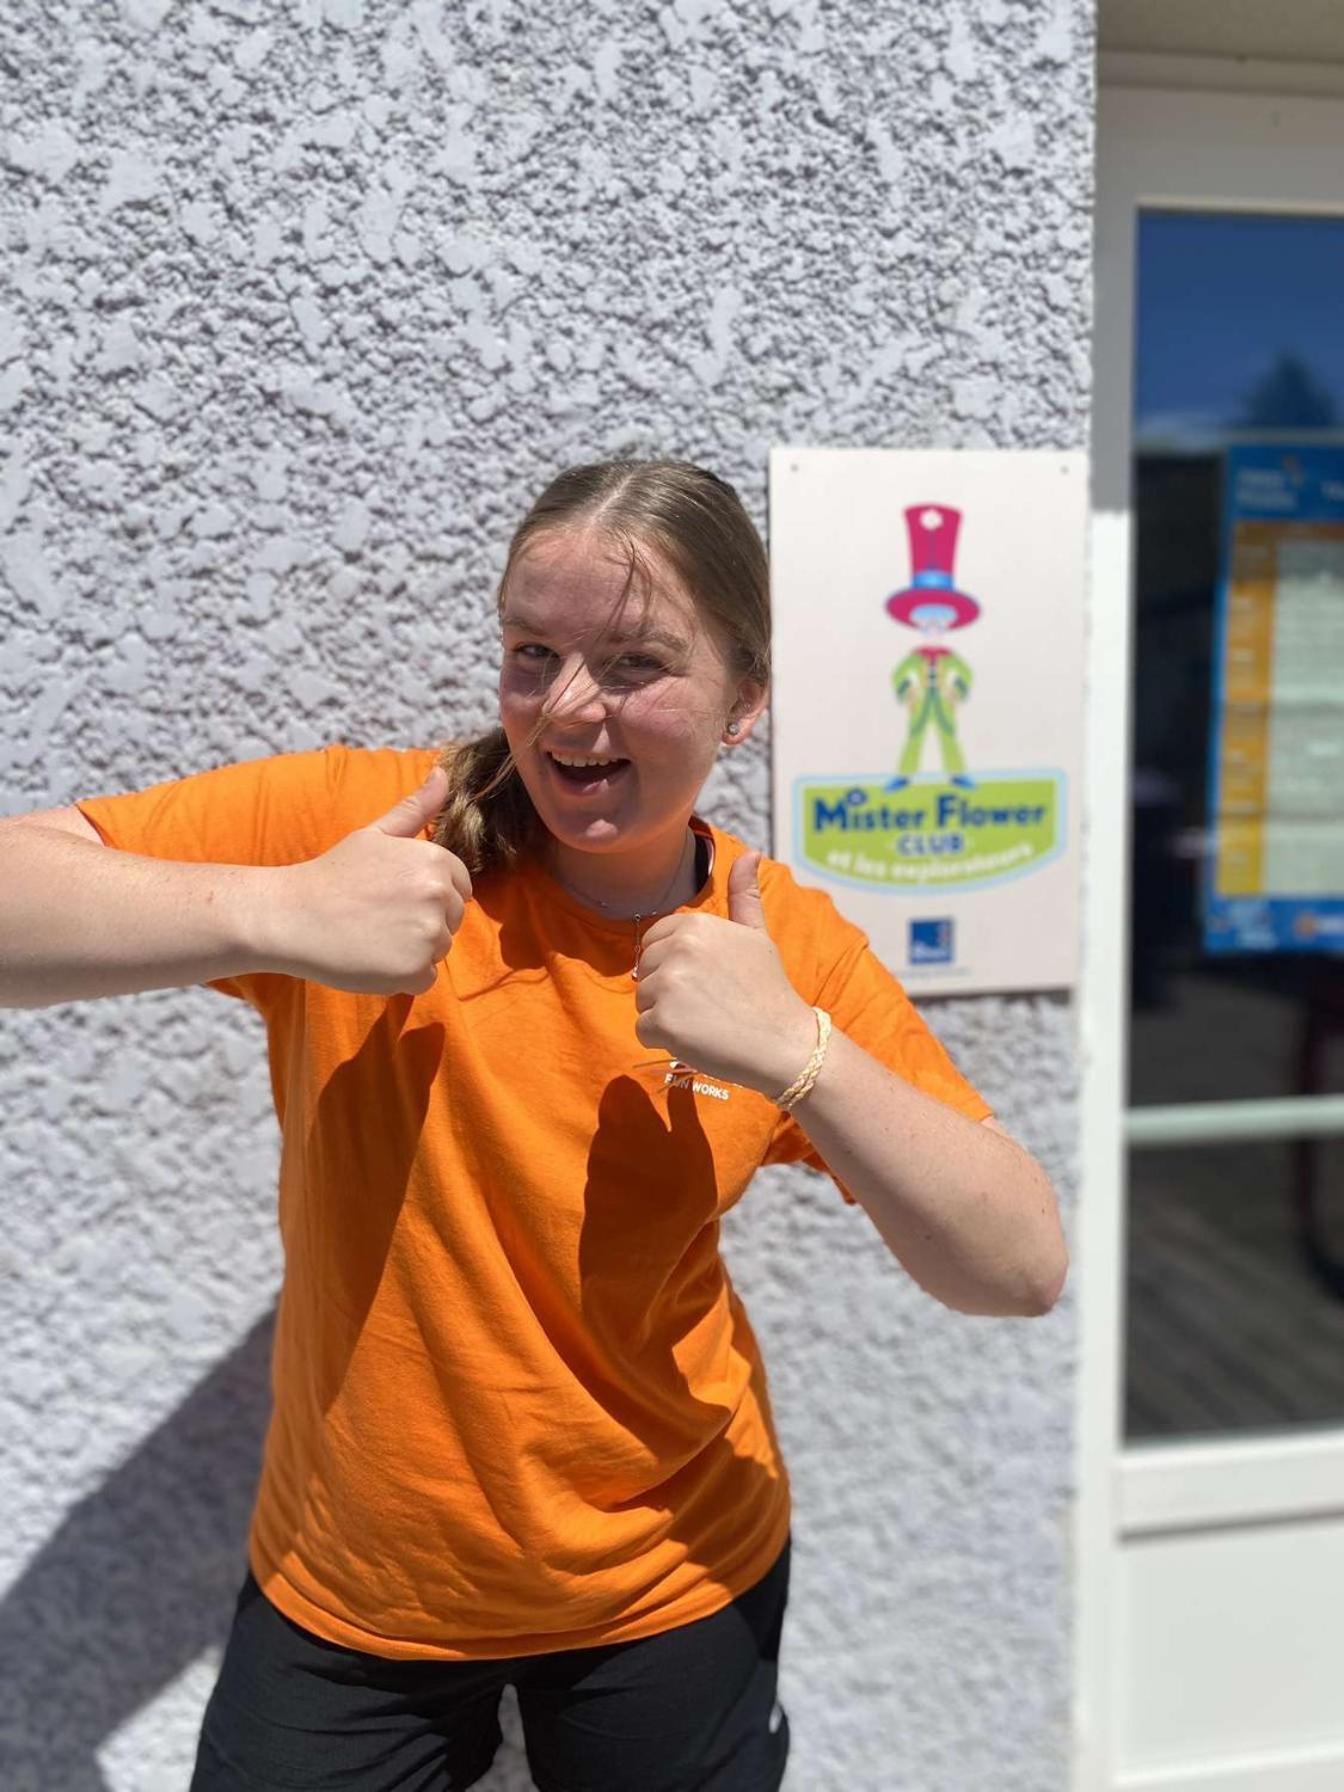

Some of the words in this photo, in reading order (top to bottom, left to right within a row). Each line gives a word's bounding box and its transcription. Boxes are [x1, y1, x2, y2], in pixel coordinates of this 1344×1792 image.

[813, 789, 925, 832] Mister
[937, 793, 1046, 828] Flower
[897, 833, 964, 856] CLUB
